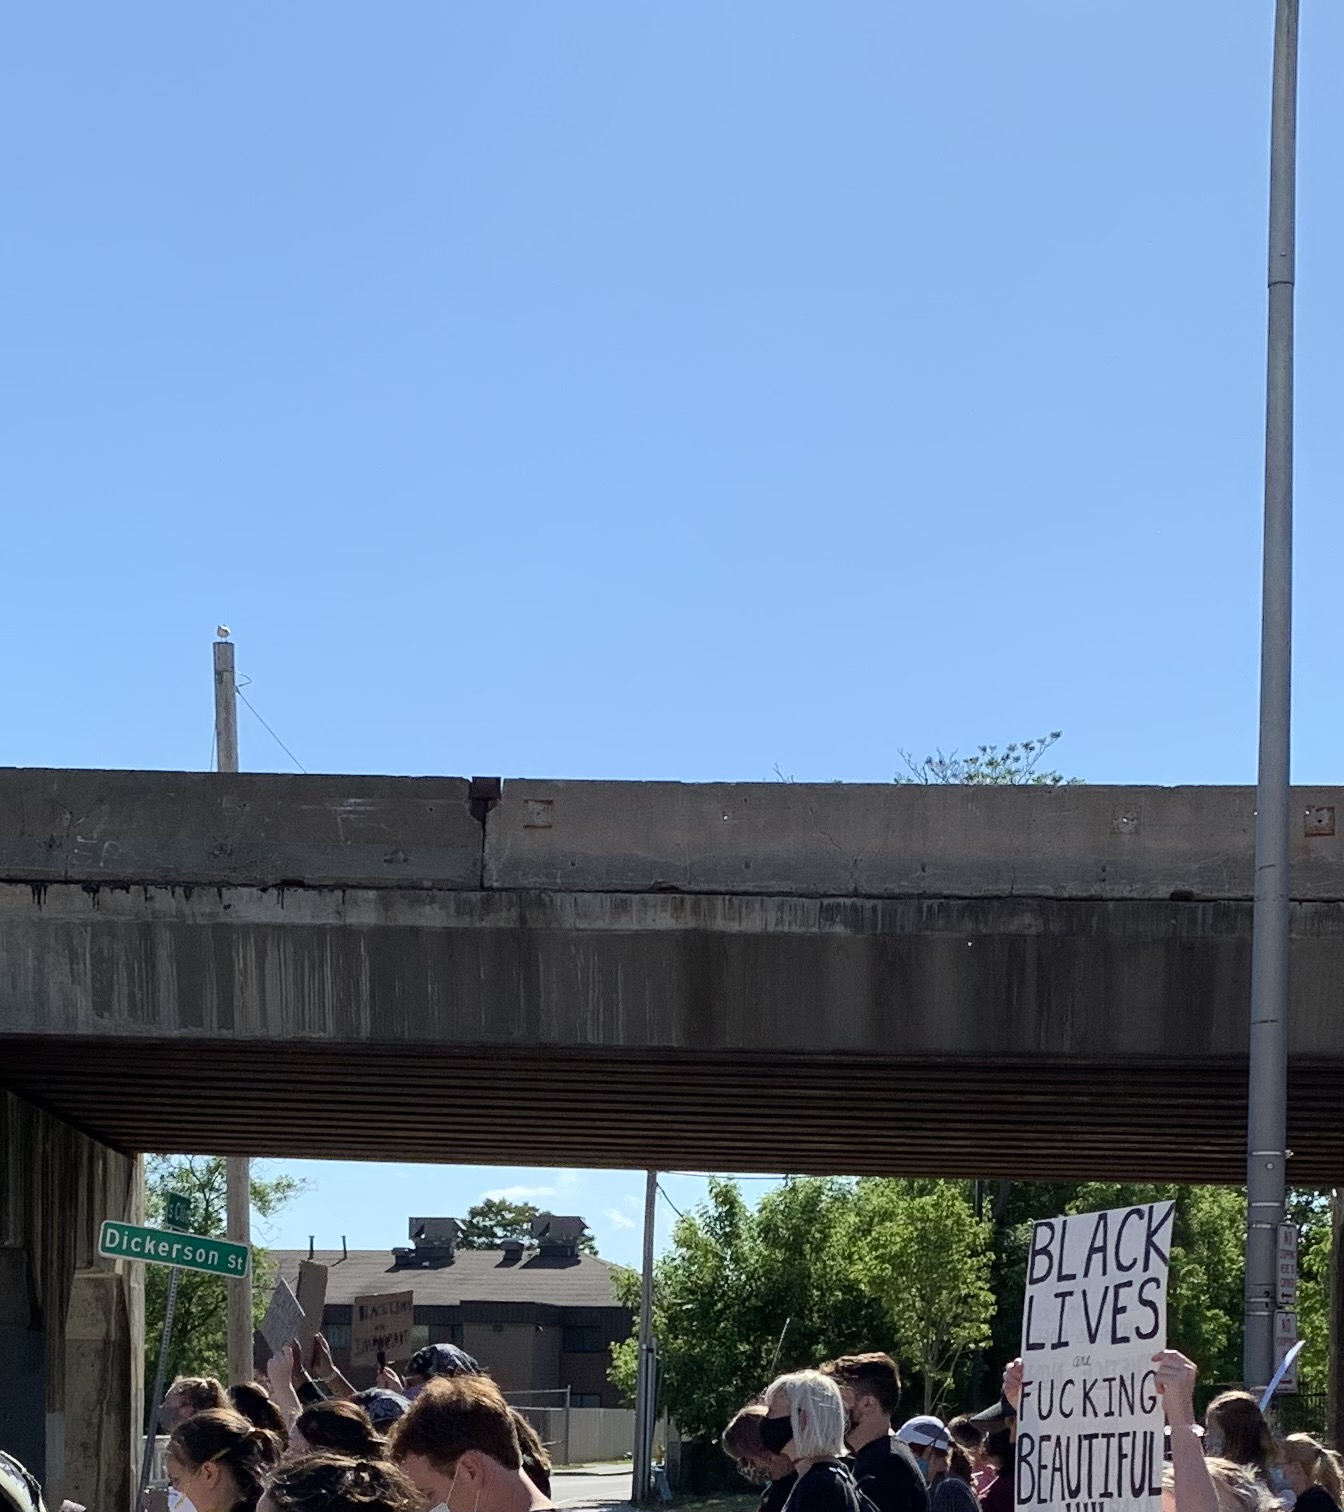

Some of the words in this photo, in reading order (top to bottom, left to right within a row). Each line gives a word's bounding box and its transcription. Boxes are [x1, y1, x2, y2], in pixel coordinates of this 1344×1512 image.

[105, 1228, 219, 1266] Dickerson
[1028, 1201, 1177, 1286] BLACK
[1025, 1276, 1161, 1351] LIVES
[1073, 1355, 1091, 1368] are
[1019, 1370, 1158, 1422] FUCKING
[1016, 1430, 1162, 1505] BEAUTIFUL
